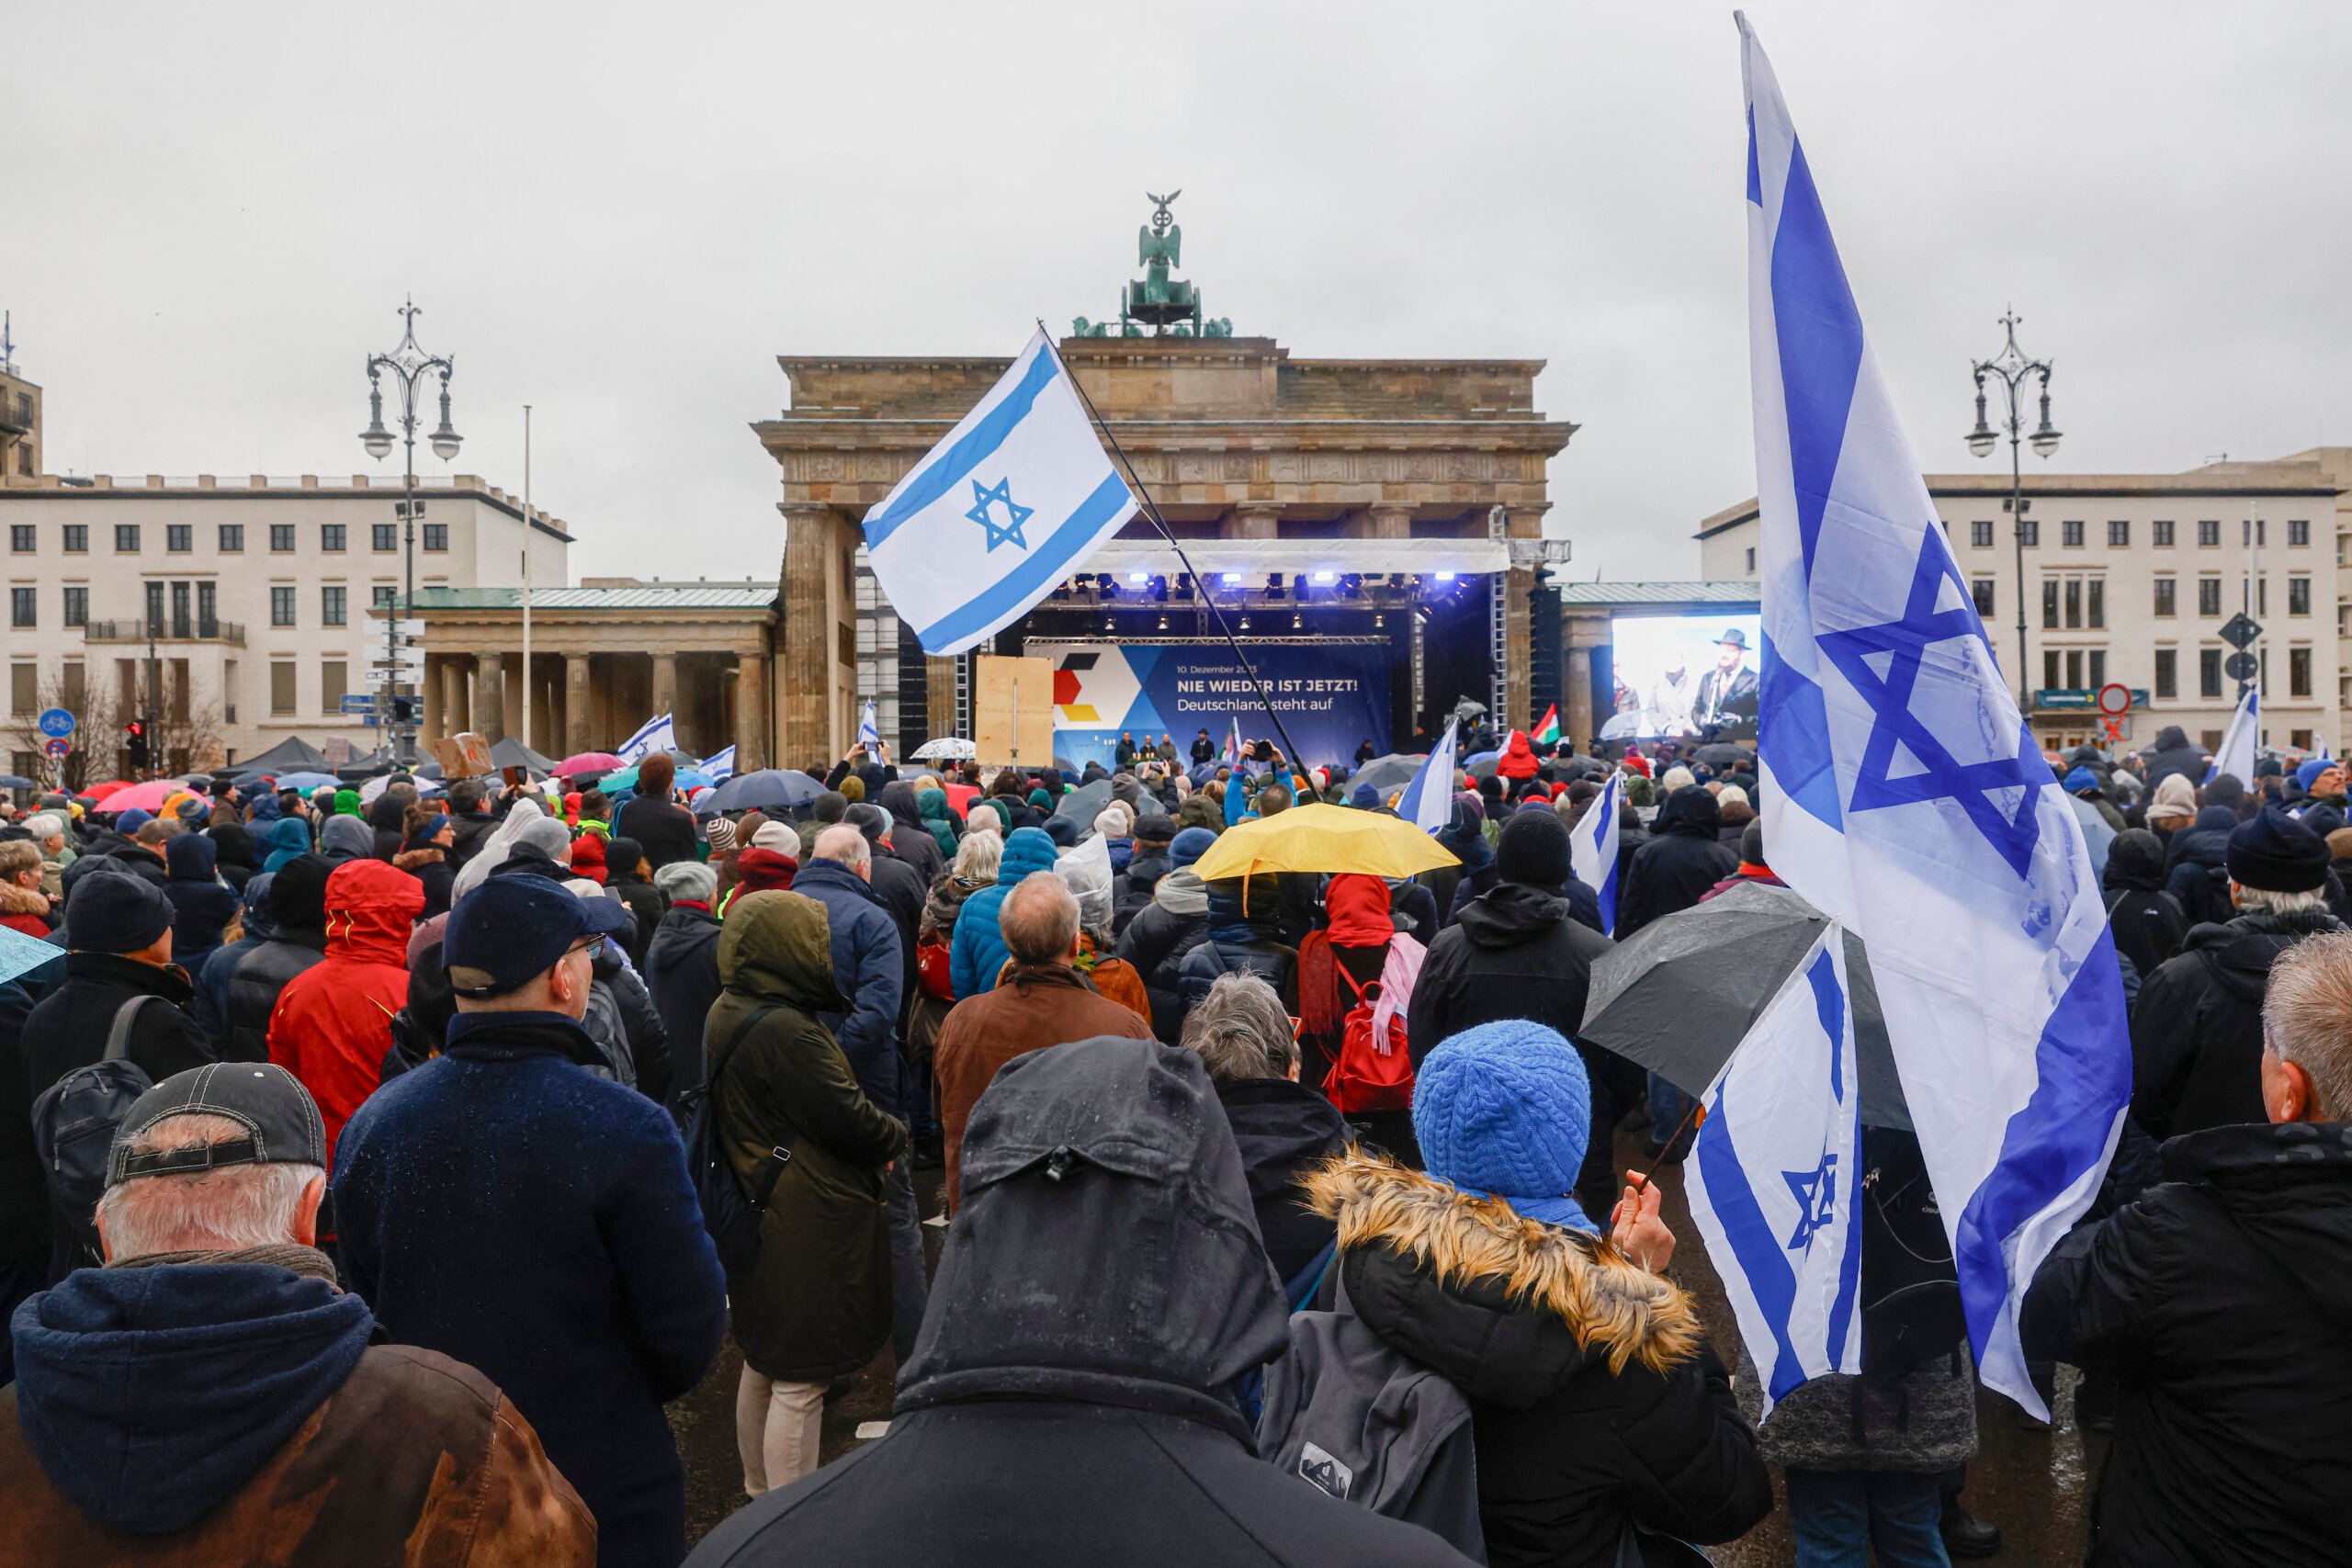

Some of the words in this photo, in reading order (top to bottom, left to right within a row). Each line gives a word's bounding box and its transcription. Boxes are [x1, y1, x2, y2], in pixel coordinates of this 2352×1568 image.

[1190, 665, 1235, 674] Dezember
[1236, 665, 1258, 674] 23
[1177, 680, 1204, 693] NIE
[1208, 680, 1274, 693] WIEDER
[1278, 680, 1303, 692] IST
[1306, 679, 1358, 692] JETZT!
[1177, 698, 1267, 712] Deutschland
[1271, 698, 1306, 711] steht
[1309, 697, 1334, 710] auf
